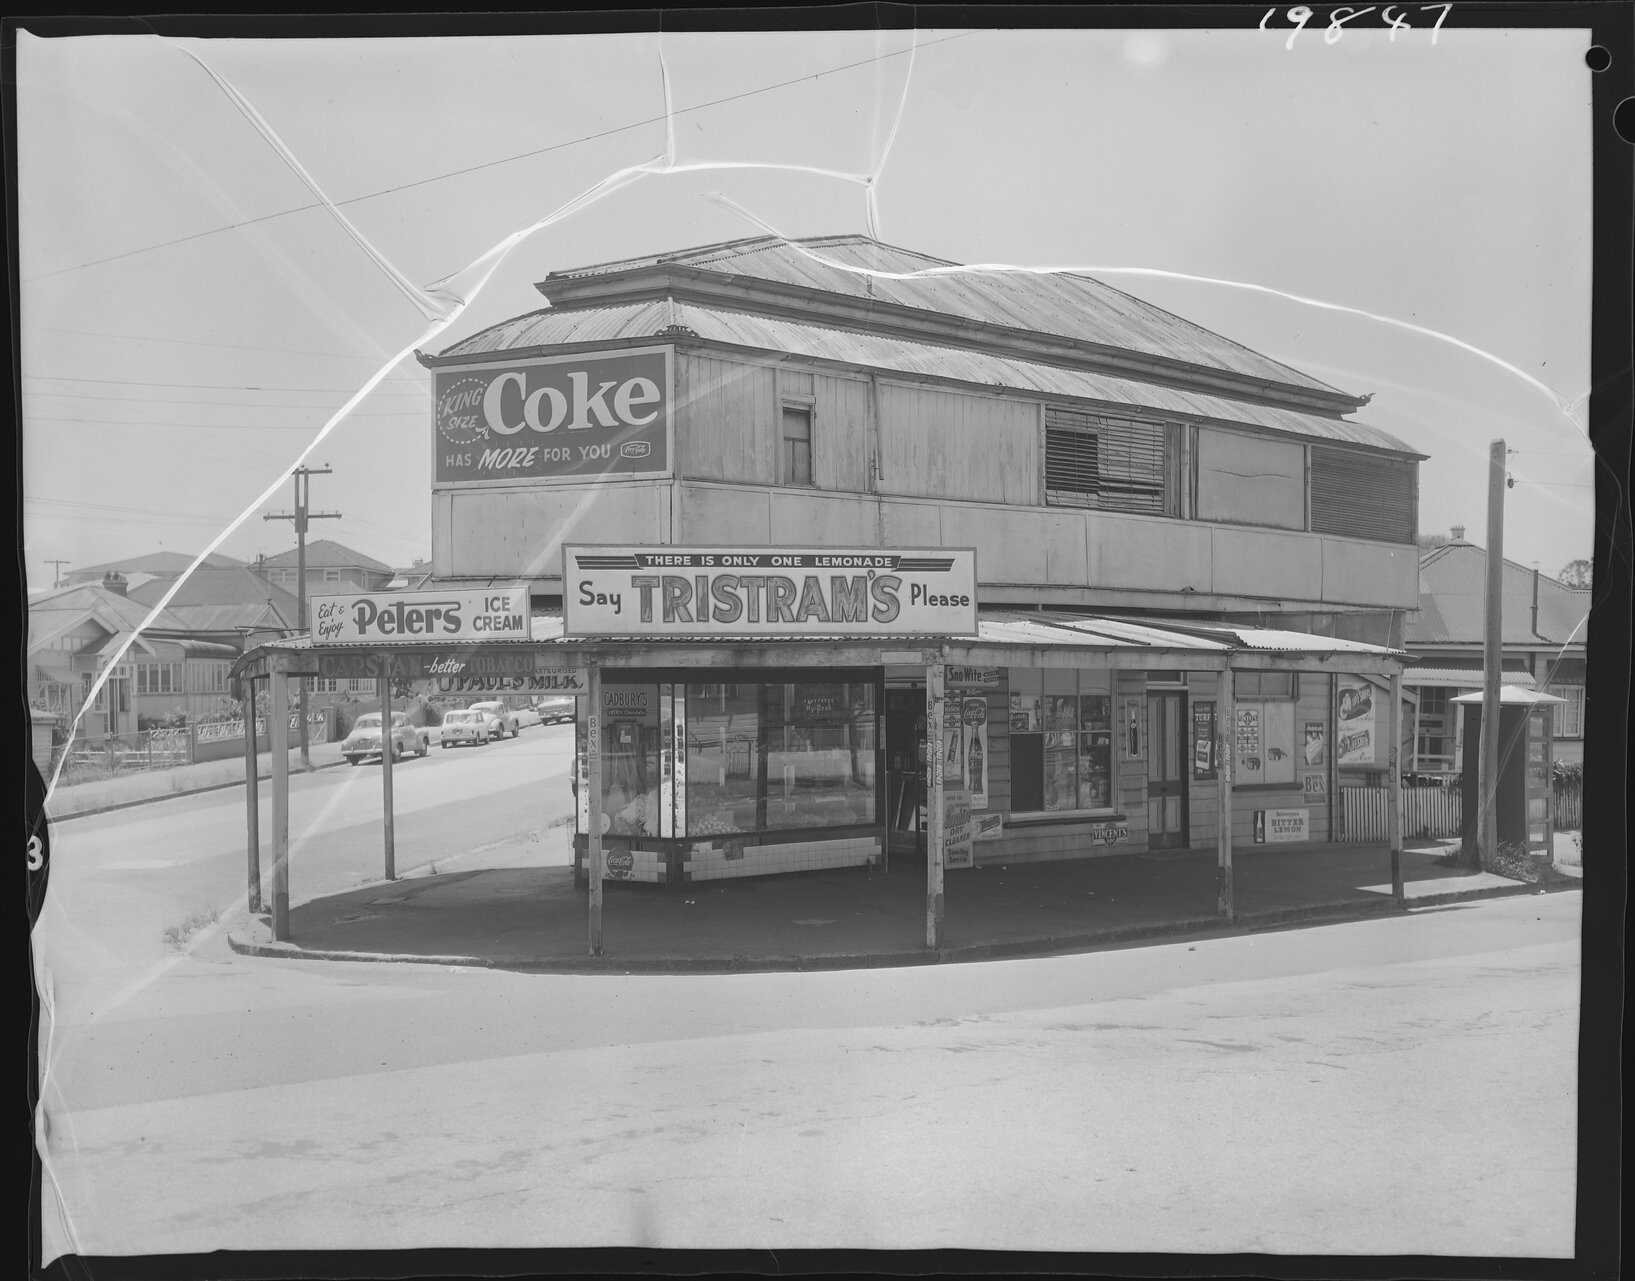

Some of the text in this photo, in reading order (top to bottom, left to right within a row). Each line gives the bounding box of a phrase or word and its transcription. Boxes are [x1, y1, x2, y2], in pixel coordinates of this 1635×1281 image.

[442, 387, 484, 418] KING
[483, 371, 661, 435] Coke
[446, 415, 478, 430] SIZE
[445, 444, 611, 470] HAS MORE FOR YOU
[644, 555, 894, 568] THERE IS ONLY ONE LEMONADE
[484, 596, 511, 613] ICE
[578, 581, 622, 615] Say
[631, 569, 904, 623] TRISTRAM'S
[909, 583, 971, 608] Please
[318, 603, 336, 620] Eat
[351, 599, 462, 635] Peters
[472, 615, 523, 632] CREAM
[318, 621, 345, 641] Enjoy
[27, 835, 43, 870] 3
